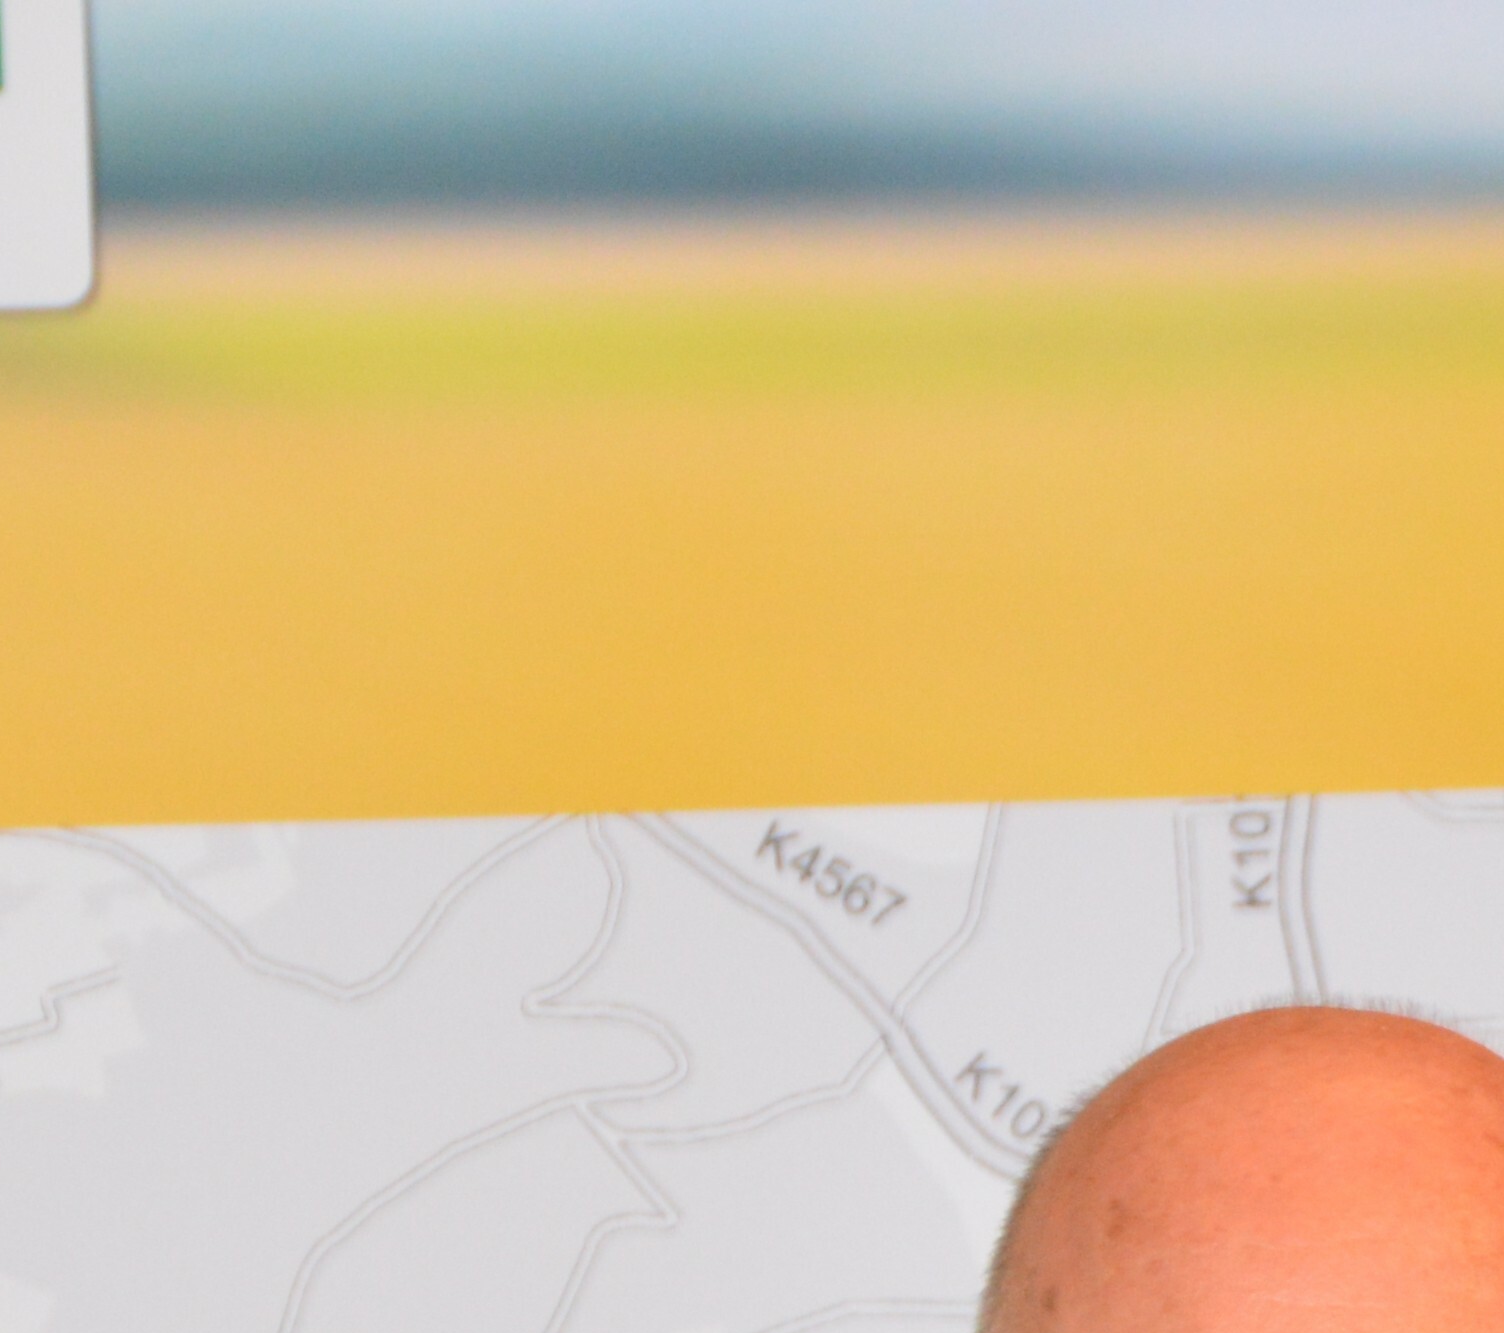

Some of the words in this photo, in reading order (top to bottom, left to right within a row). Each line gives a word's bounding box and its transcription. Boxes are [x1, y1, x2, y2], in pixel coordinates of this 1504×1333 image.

[756, 820, 907, 929] K4567
[1228, 794, 1273, 910] K10
[953, 1051, 1052, 1140] K10
